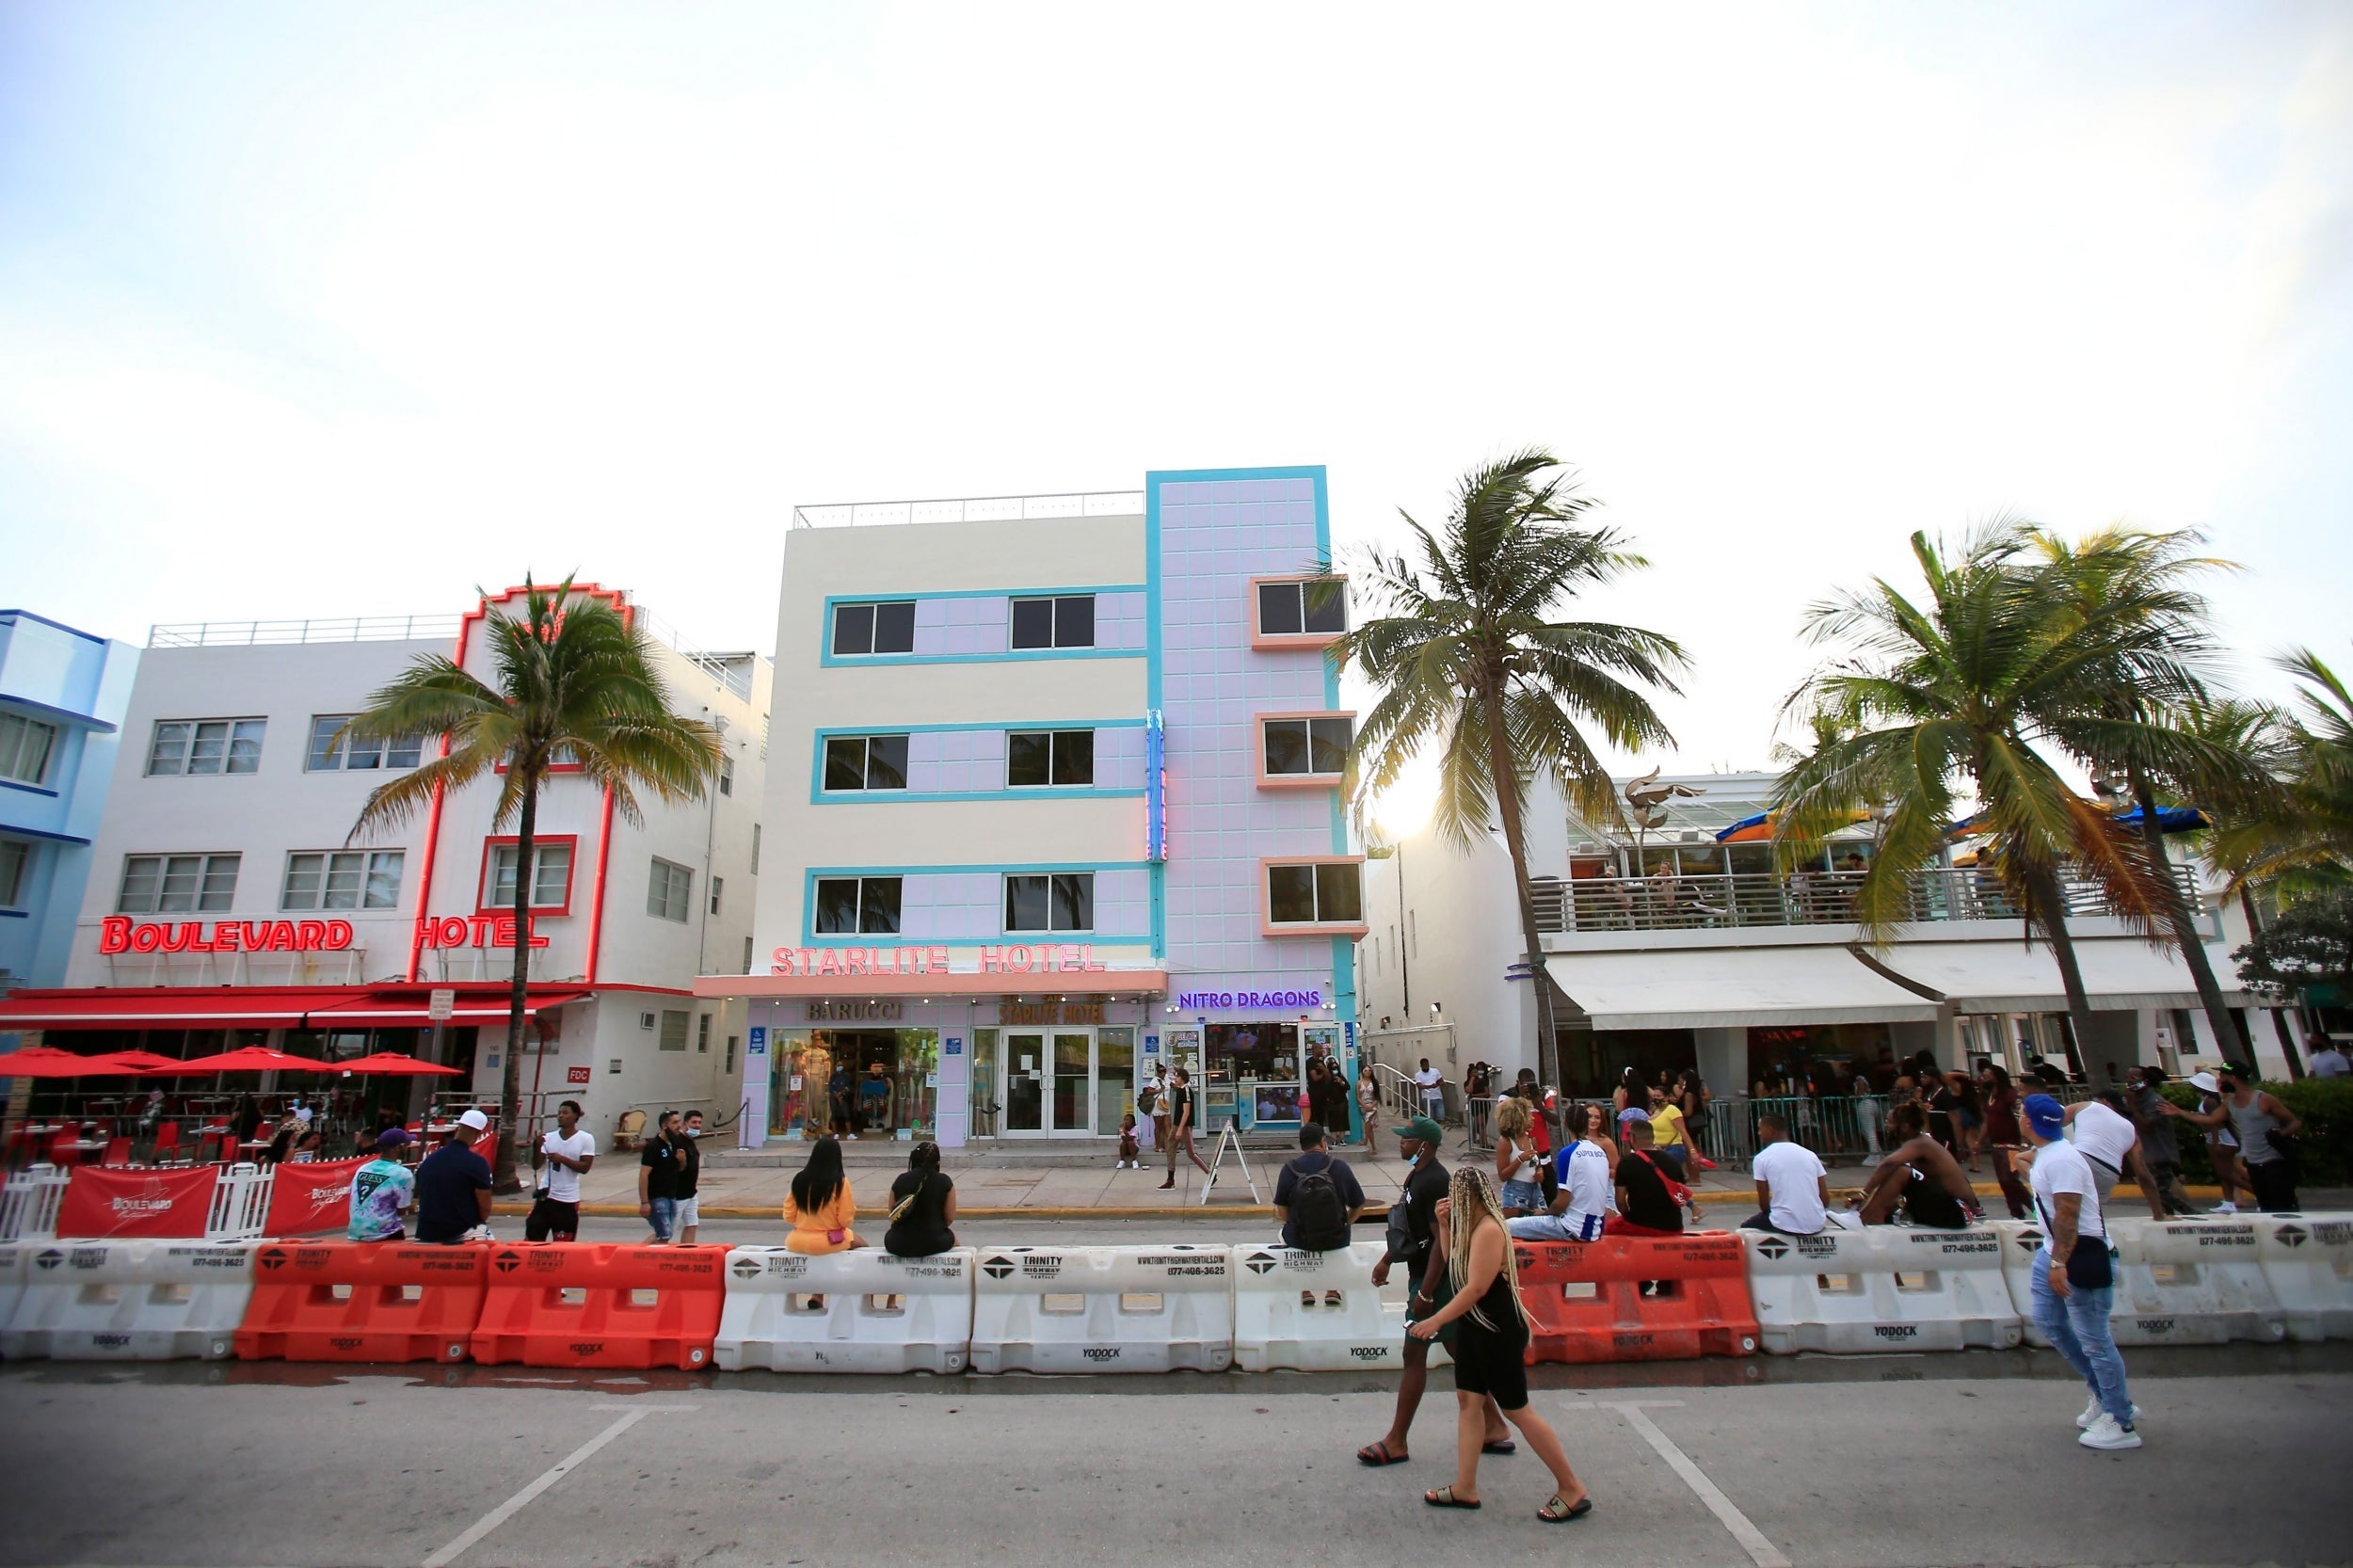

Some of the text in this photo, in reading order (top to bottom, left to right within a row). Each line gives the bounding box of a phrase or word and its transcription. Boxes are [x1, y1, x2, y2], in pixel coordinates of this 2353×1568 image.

[100, 916, 353, 953] BOULEVARD
[413, 916, 550, 949] HOTEL
[771, 943, 1106, 977] STARLITE HOTEL
[1179, 990, 1320, 1008] NITRO DRAGONS
[806, 1001, 904, 1022] BARUCCI
[999, 1003, 1107, 1026] STARLITE HOTEL
[570, 1070, 588, 1080] FDC
[661, 1148, 668, 1158] 3
[358, 1172, 383, 1184] GUESS
[112, 1196, 173, 1210] BOULEVARD
[1796, 1236, 1835, 1246] TRINITY
[296, 1249, 332, 1257] TRINITY
[1545, 1246, 1585, 1256] TRINITY
[1942, 1242, 1998, 1254] 877-496-3625
[528, 1250, 565, 1259] TRINITY
[1284, 1251, 1323, 1260] TRINITY
[769, 1256, 808, 1267] TRINITY
[1023, 1256, 1064, 1266] TRINITY
[1874, 1326, 1917, 1336] YODOCK
[1082, 1347, 1121, 1358] YODOCK
[1350, 1347, 1389, 1356] YODOCK
